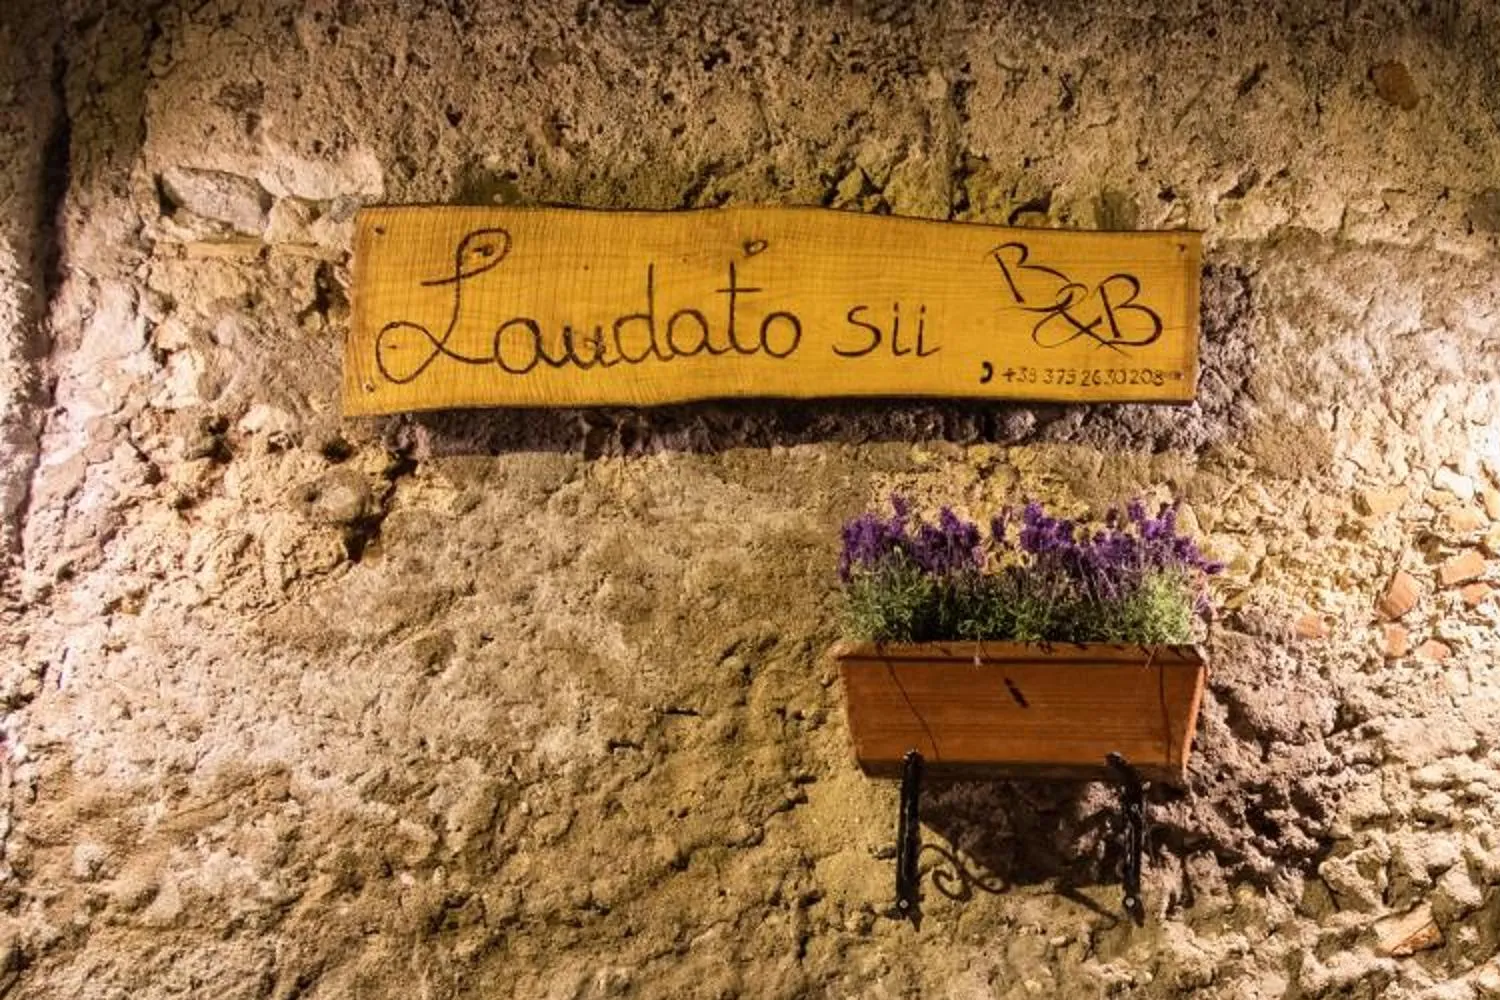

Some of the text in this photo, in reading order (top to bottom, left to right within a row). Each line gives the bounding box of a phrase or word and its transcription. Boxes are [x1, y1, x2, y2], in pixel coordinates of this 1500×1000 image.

[375, 228, 944, 384] Laudato sii
[983, 242, 1163, 358] B&B
